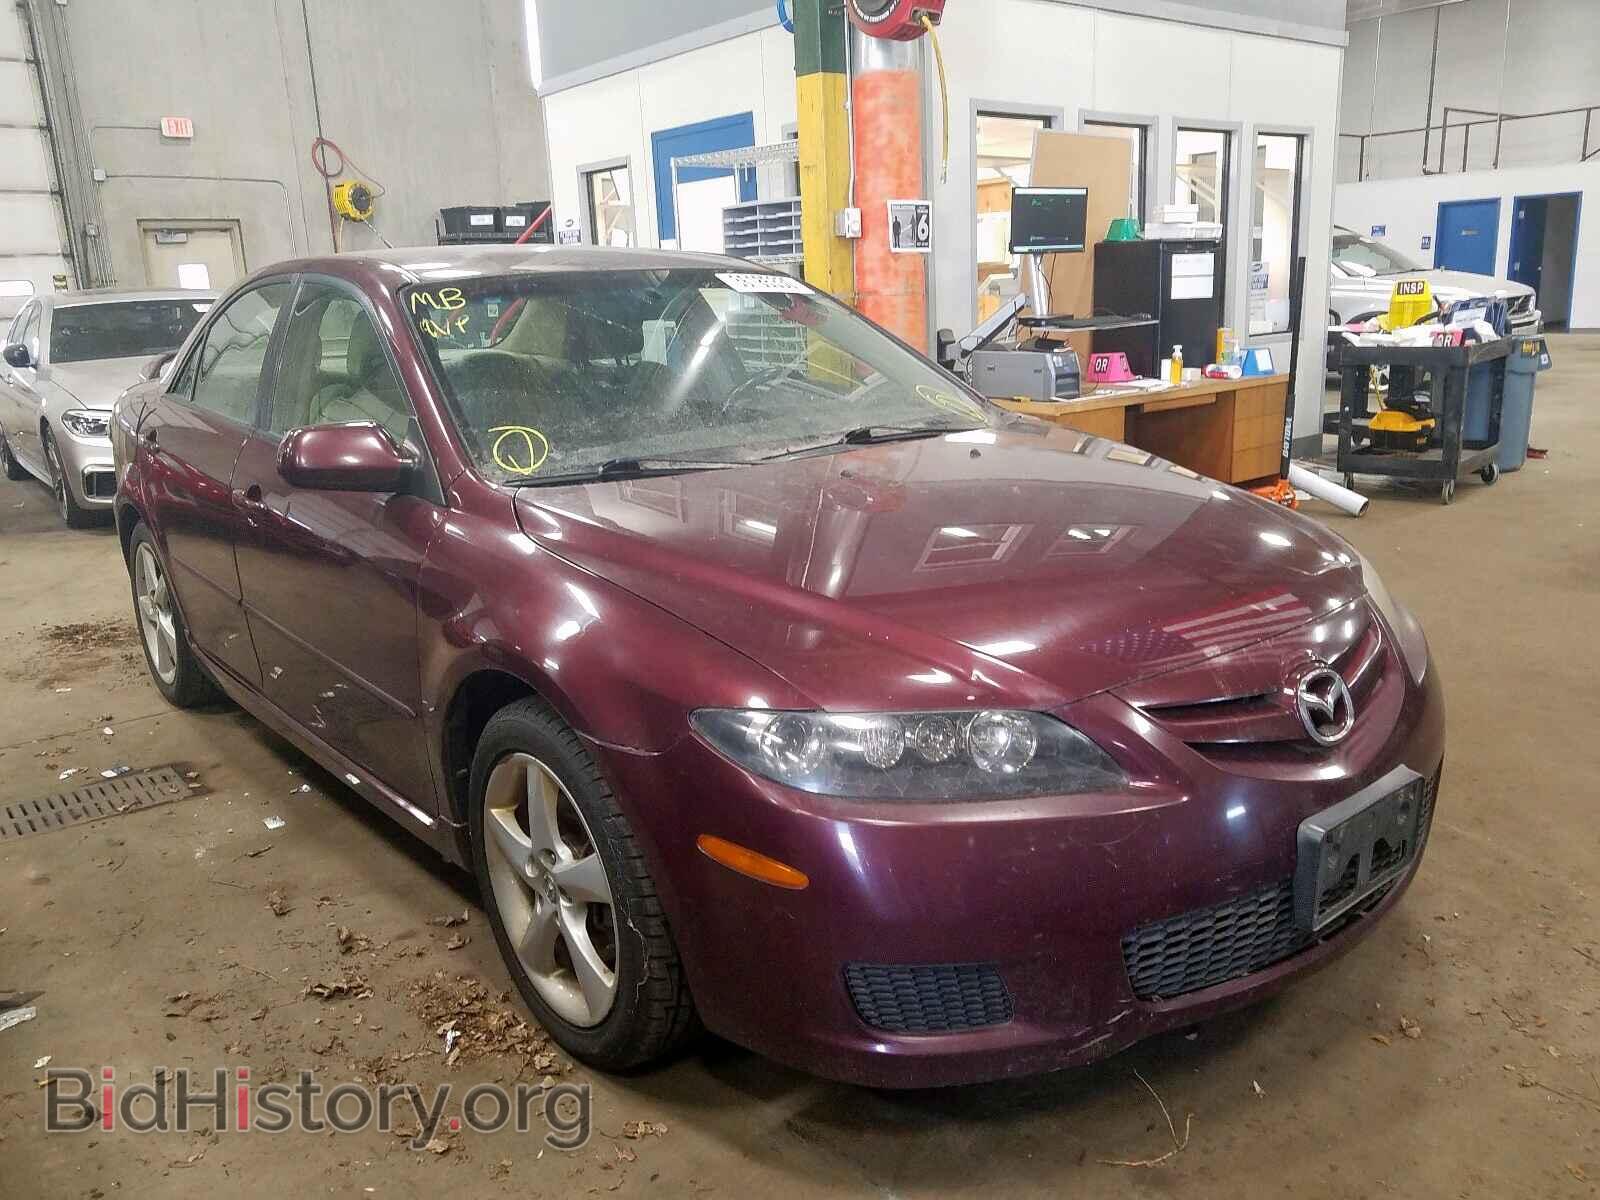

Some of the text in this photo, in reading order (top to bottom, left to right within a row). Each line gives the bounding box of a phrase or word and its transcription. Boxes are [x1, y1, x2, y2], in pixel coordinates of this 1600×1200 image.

[166, 119, 190, 136] EXIT
[918, 214, 929, 241] 6
[1399, 282, 1424, 295] INSP
[411, 287, 466, 315] MB
[1095, 357, 1109, 372] OR
